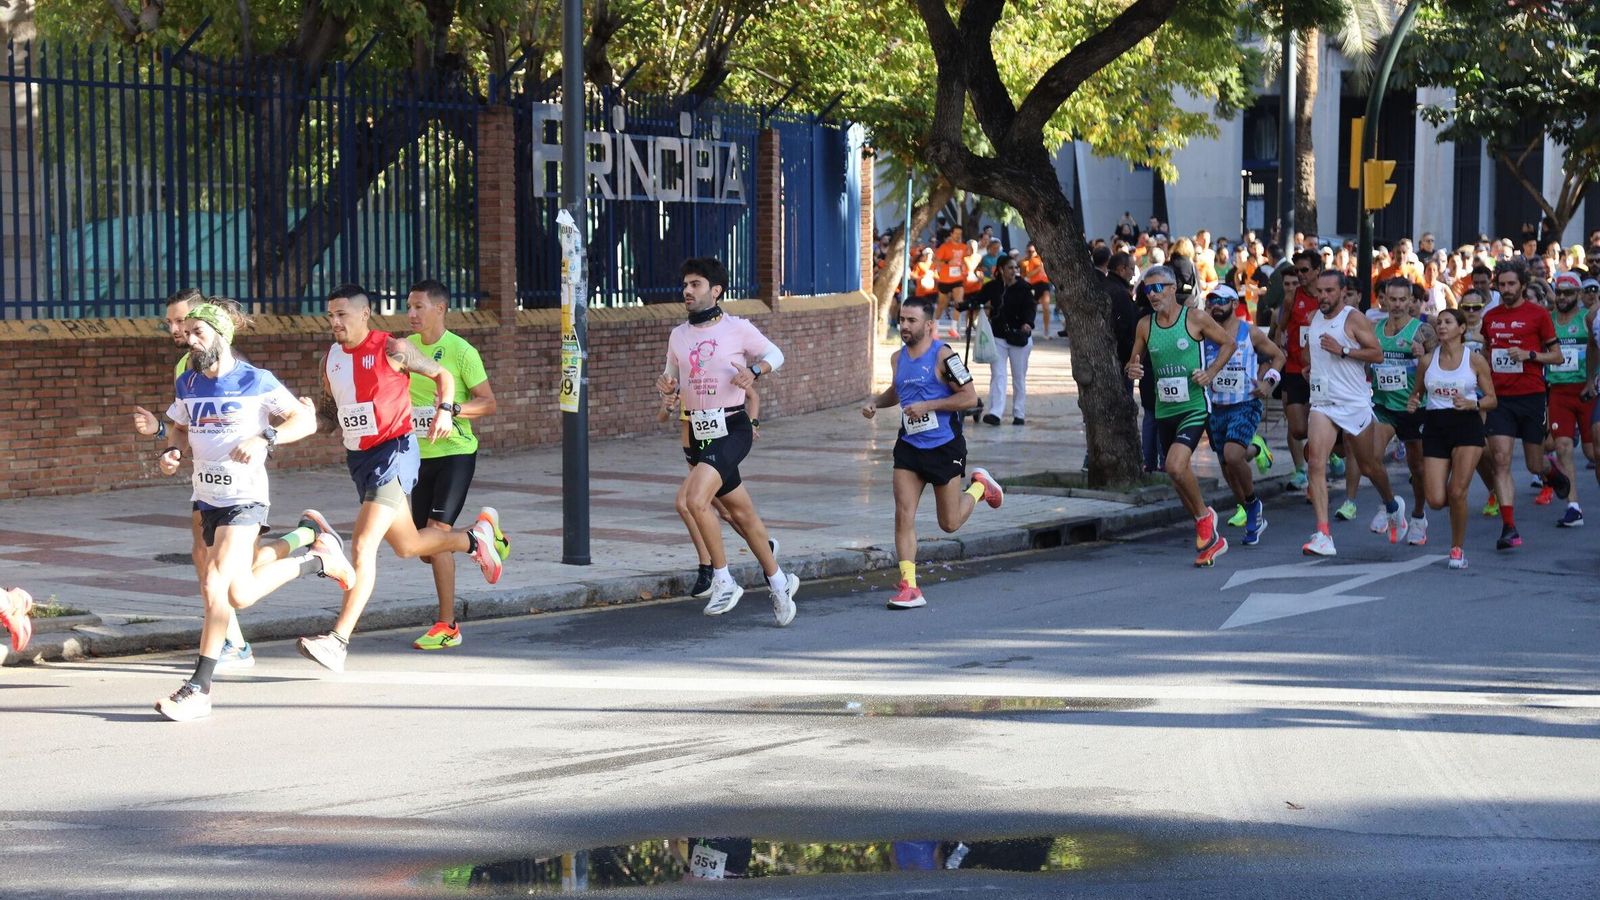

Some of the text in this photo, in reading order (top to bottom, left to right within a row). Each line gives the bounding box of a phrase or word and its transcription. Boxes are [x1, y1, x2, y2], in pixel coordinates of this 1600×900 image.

[532, 101, 747, 204] PRINCIPIA
[1217, 377, 1238, 387] 287
[1380, 375, 1401, 384] 365
[1163, 386, 1178, 396] 90
[343, 414, 368, 428] 838
[695, 419, 719, 432] 324
[197, 472, 232, 485] 1029
